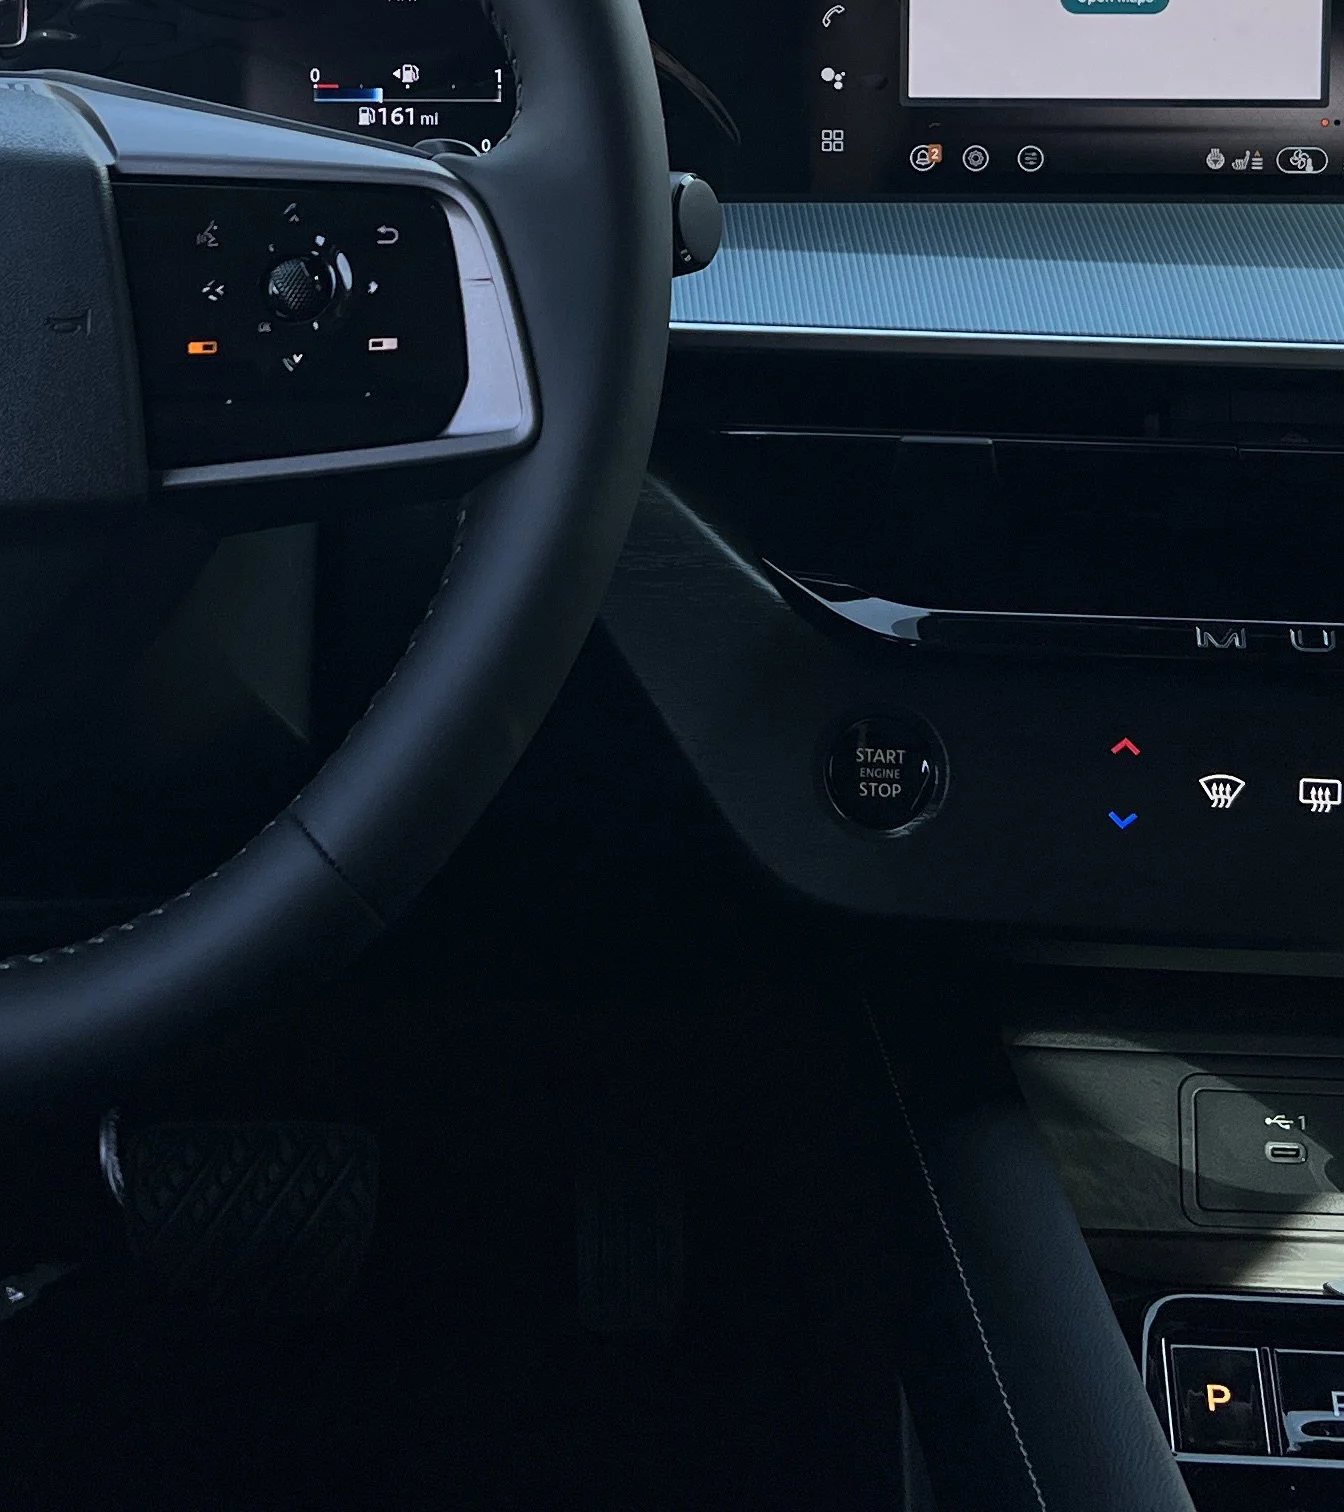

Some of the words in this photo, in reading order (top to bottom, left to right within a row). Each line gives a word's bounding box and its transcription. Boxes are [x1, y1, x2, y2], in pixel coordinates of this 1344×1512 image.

[310, 67, 321, 83] 0
[494, 69, 502, 83] 1
[378, 107, 415, 125] 161
[420, 112, 439, 126] mi
[856, 747, 906, 764] START
[859, 768, 901, 779] ENGINE
[859, 781, 902, 797] STOP
[1206, 1384, 1231, 1411] P
